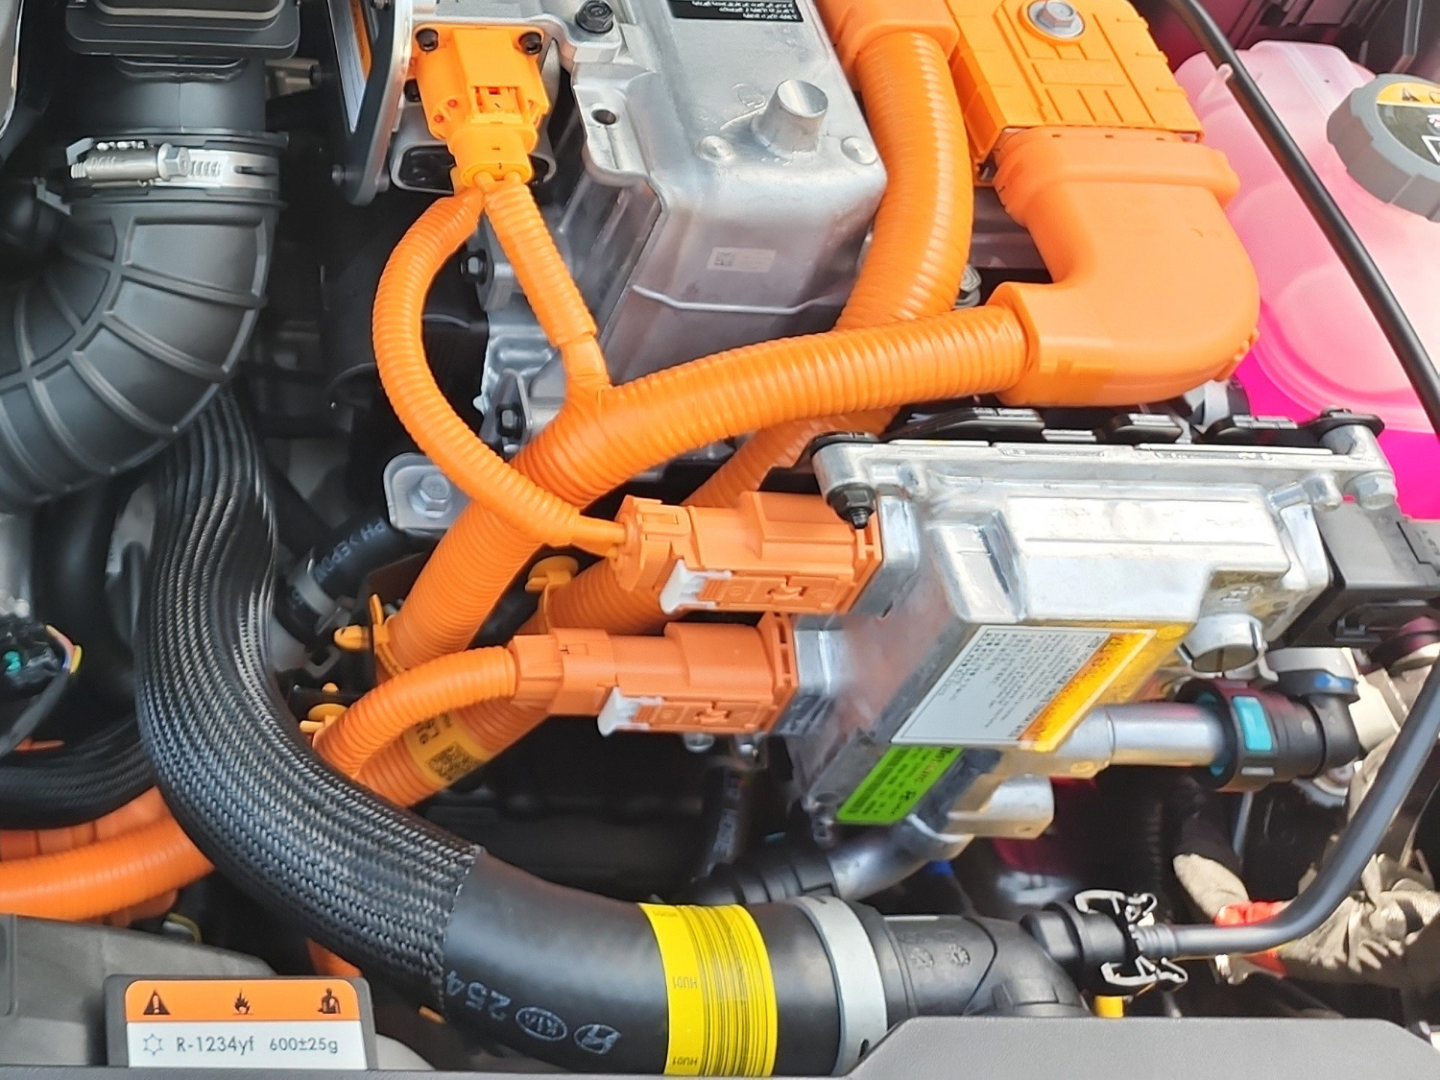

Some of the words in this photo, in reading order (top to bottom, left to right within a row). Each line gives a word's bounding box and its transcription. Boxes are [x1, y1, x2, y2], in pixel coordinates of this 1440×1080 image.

[521, 1008, 562, 1038] KIA
[176, 1035, 255, 1056] R-1234yf
[269, 1036, 339, 1055] 600±25g
